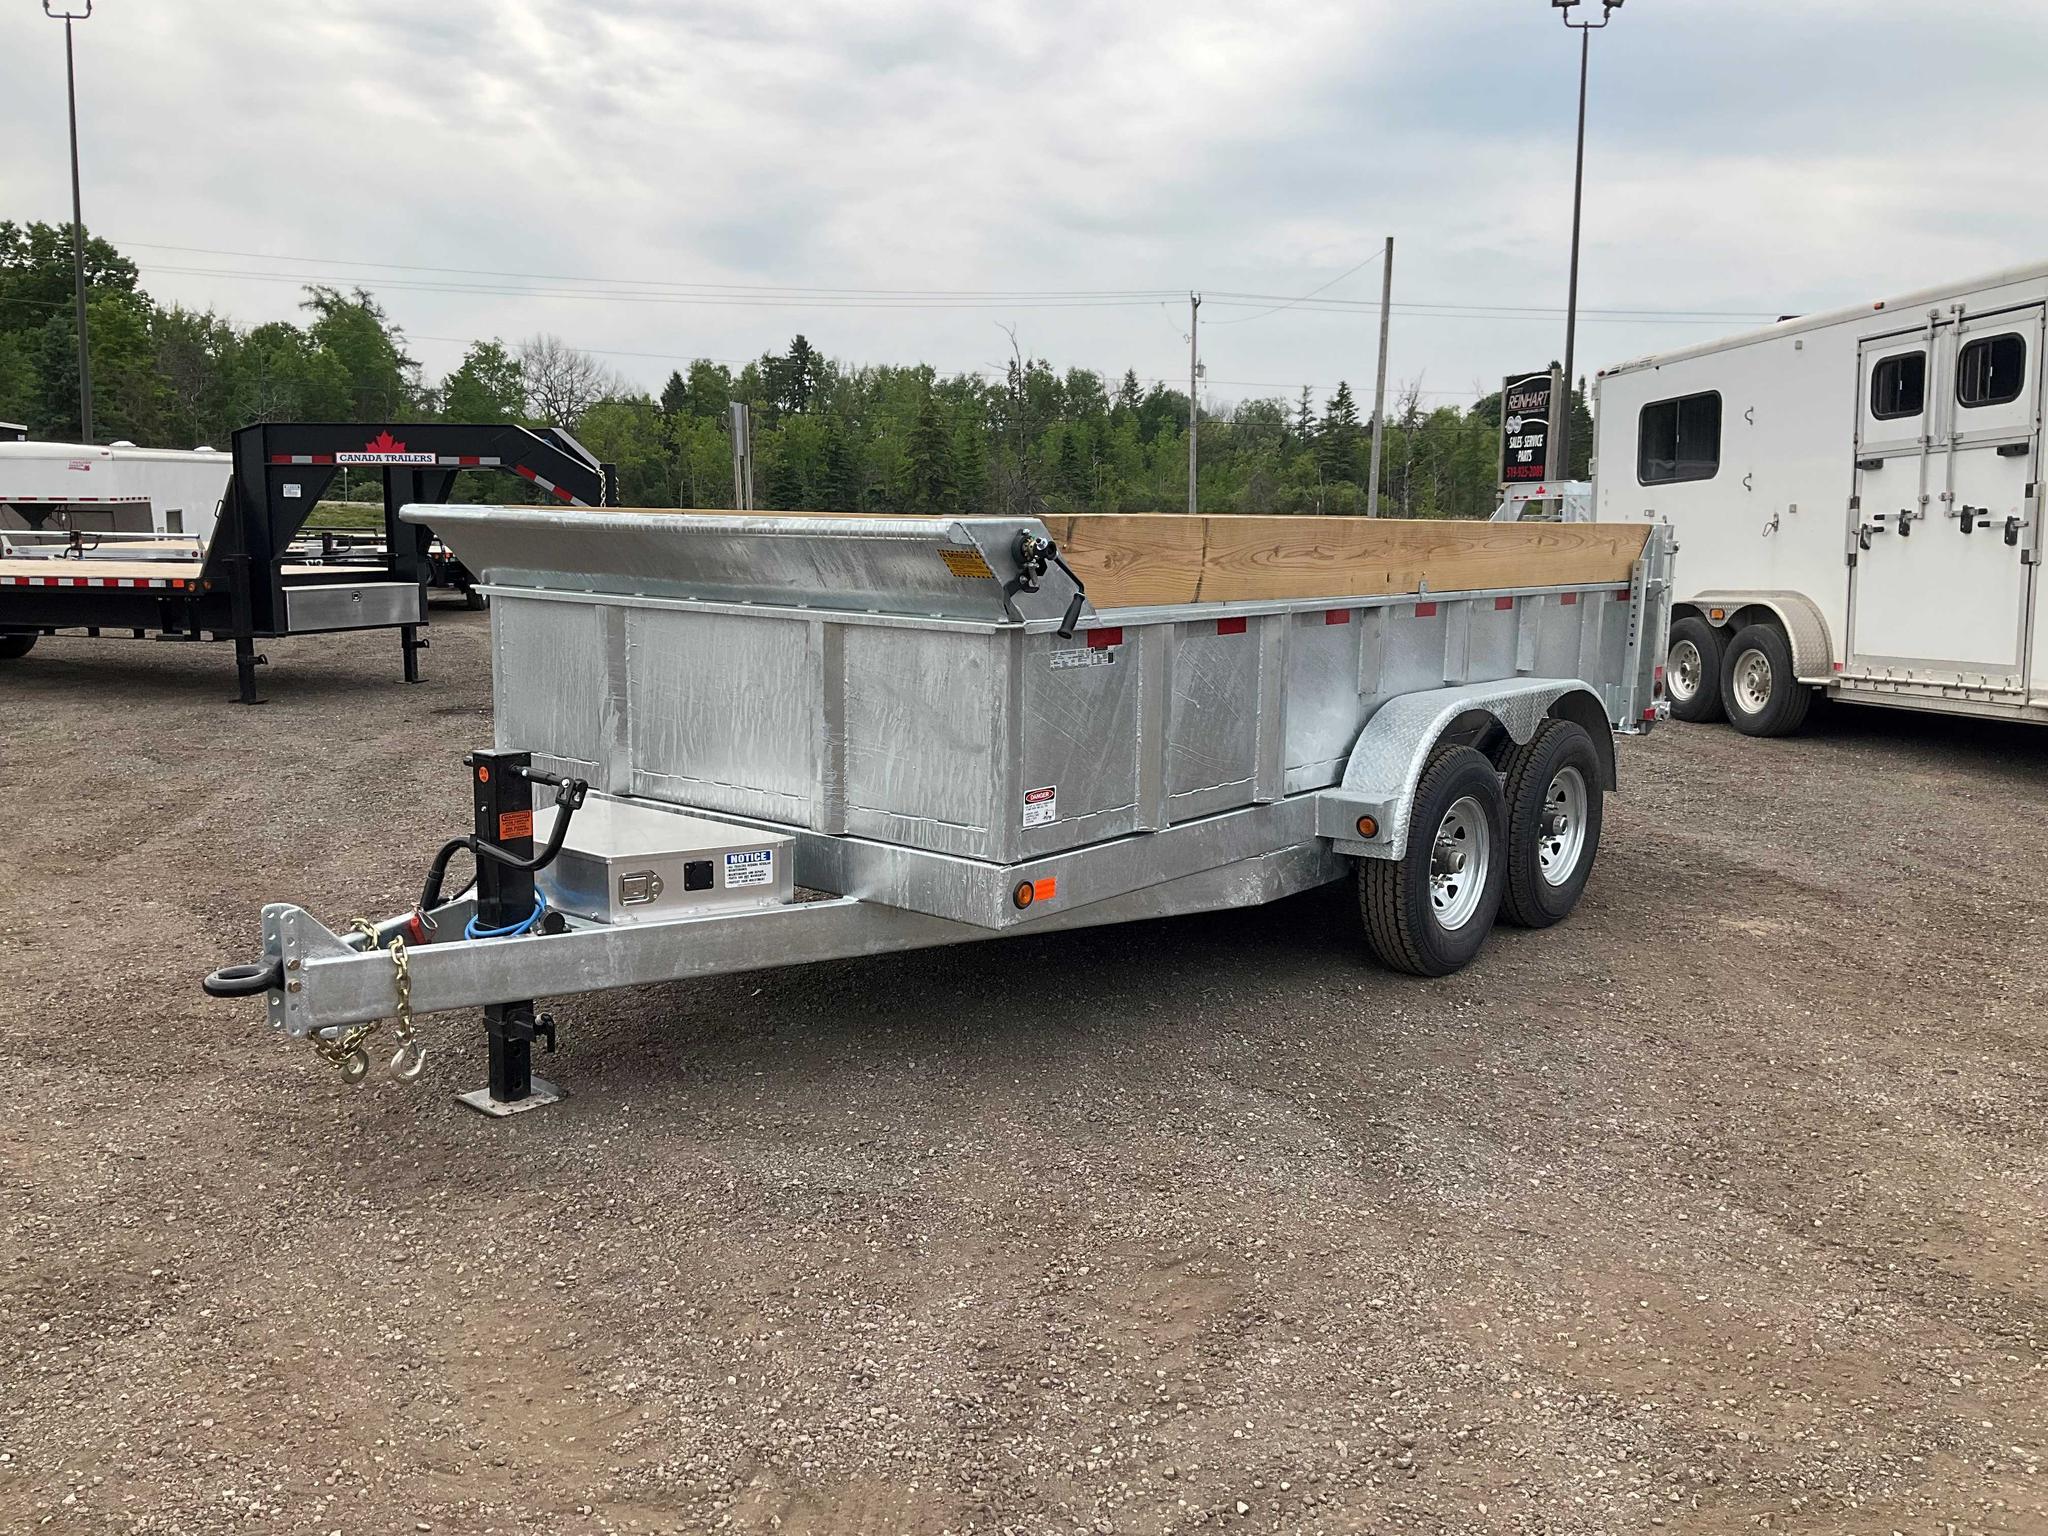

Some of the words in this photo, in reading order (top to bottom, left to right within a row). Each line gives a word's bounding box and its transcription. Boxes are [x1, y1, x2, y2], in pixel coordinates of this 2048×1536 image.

[1508, 390, 1550, 410] REINHART
[1509, 436, 1523, 449] SALES
[1524, 434, 1544, 448] SERVICE
[339, 454, 382, 462] CANADA
[385, 454, 433, 462] TRAILERS
[1517, 449, 1533, 462] PARTS
[1030, 792, 1049, 800] DANGER
[730, 852, 766, 863] NOTICE
